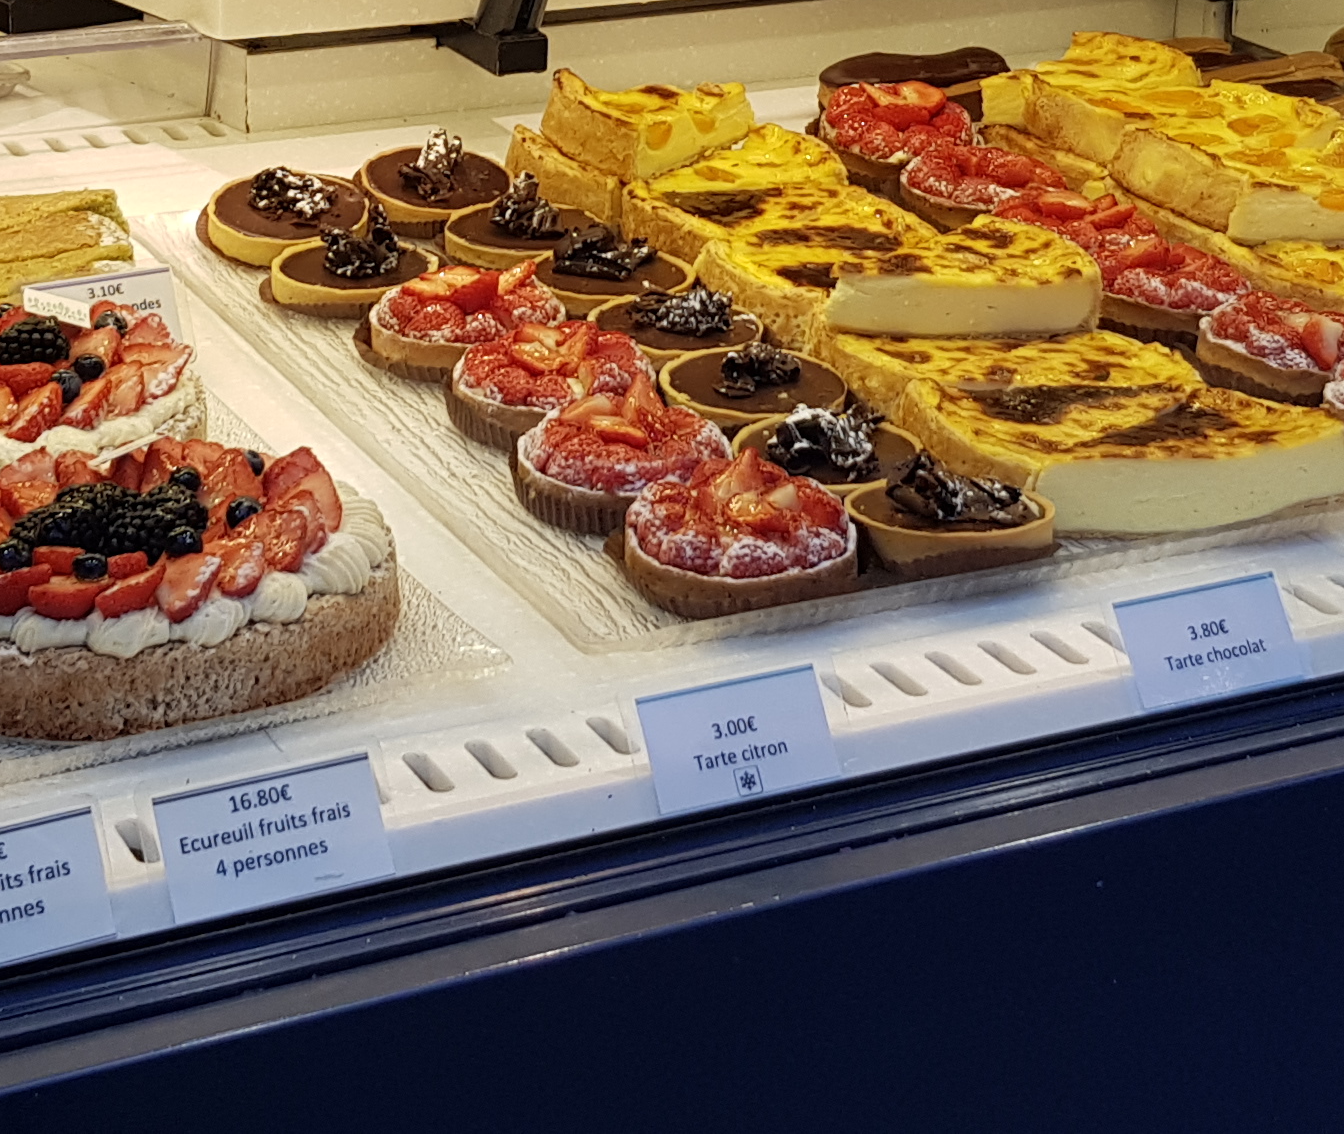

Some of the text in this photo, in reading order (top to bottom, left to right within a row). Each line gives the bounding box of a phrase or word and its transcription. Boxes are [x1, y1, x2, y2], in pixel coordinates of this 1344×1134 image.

[87, 283, 125, 299] 3.10€
[1187, 618, 1230, 641] 3.80€
[1164, 638, 1267, 671] Tarte chocolat
[711, 715, 758, 740] 3.00€
[693, 741, 788, 771] Tarte citron
[228, 784, 293, 813] 16.80€
[179, 802, 351, 855] Ecureuil fruits frais
[28, 859, 72, 884] frais
[215, 838, 329, 878] 4 personnes
